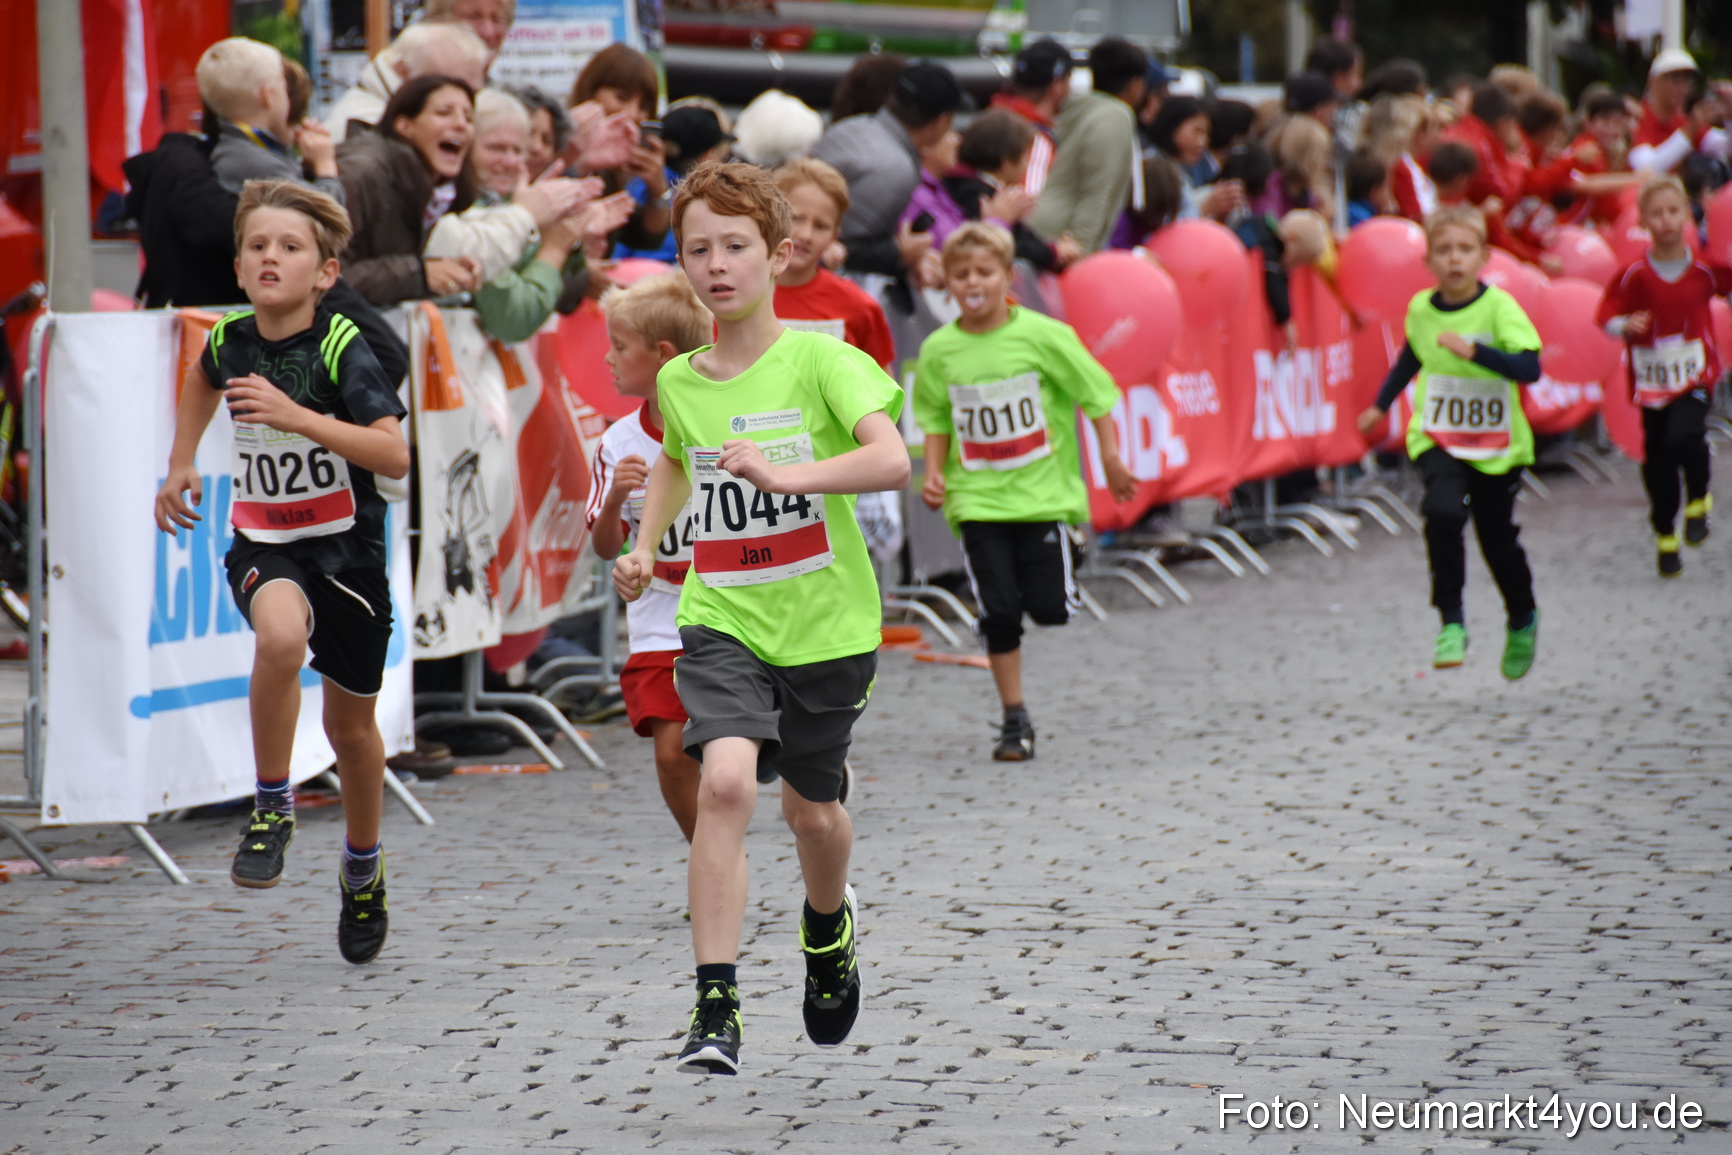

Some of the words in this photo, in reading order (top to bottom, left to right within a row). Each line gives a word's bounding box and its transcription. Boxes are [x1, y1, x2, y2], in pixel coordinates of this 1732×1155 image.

[960, 397, 1035, 438] 7010
[1430, 396, 1504, 427] 7089
[239, 446, 336, 497] 7026
[700, 481, 811, 532] 7044
[740, 546, 773, 566] Jan
